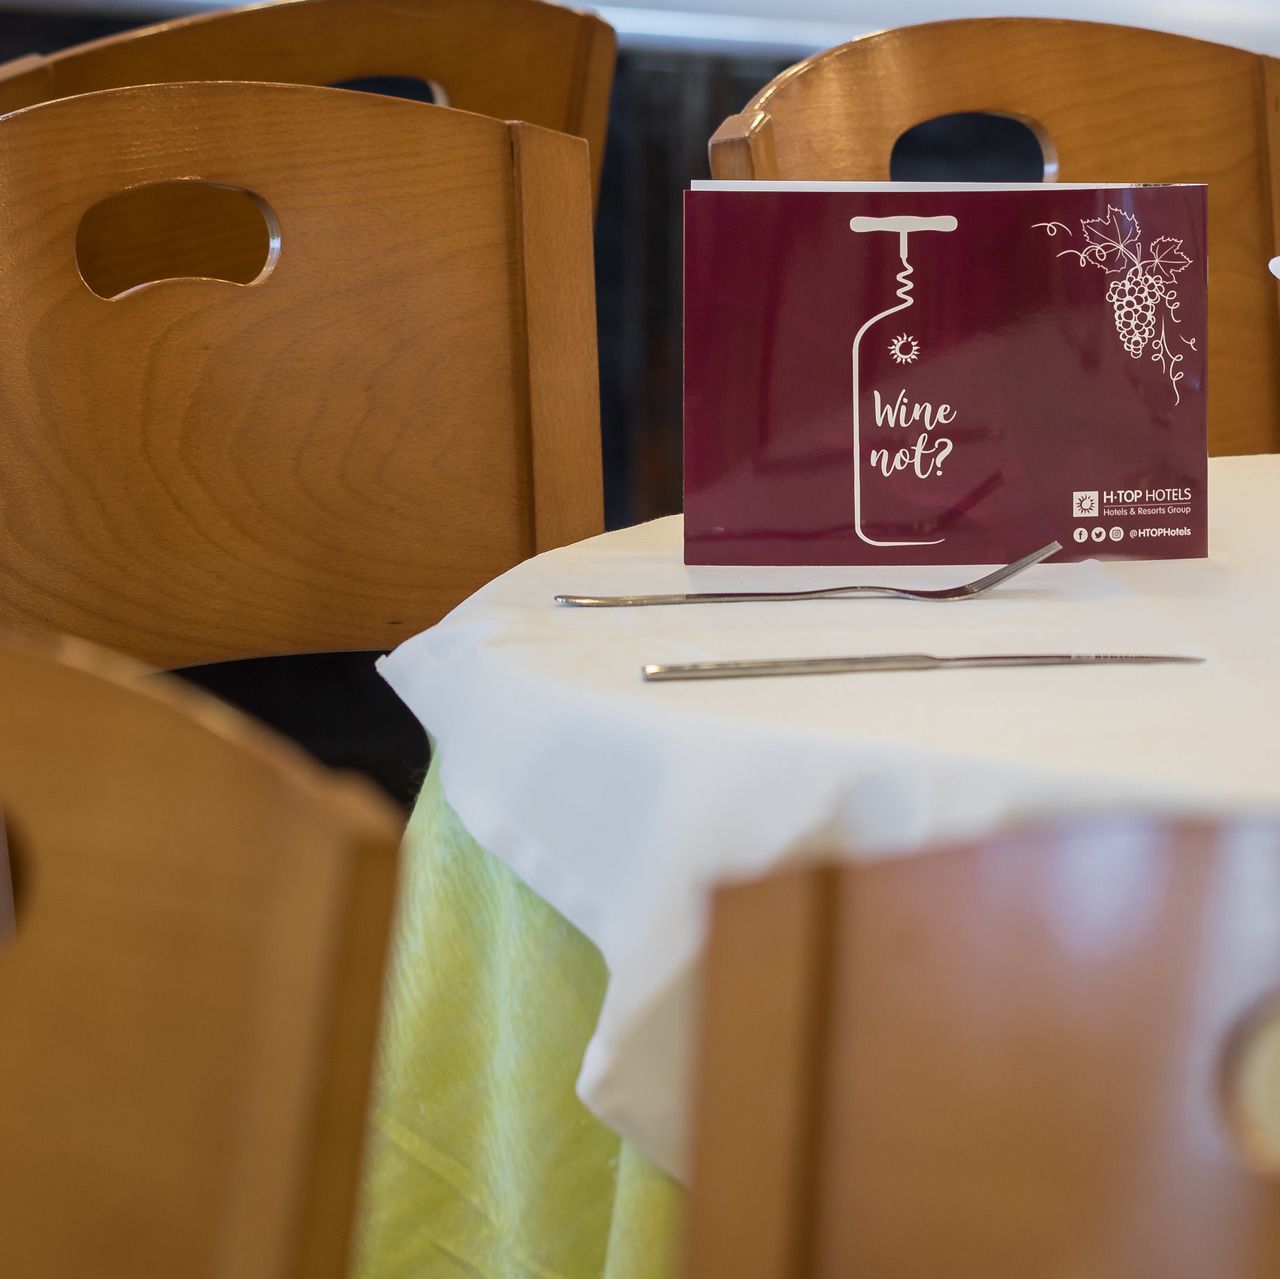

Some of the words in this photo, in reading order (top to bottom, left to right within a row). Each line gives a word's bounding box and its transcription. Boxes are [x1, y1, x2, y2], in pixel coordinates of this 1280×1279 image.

[873, 388, 957, 430] Wine
[870, 433, 953, 479] not?
[1145, 487, 1192, 502] HOTELS
[1103, 508, 1128, 516] Hotels
[1137, 506, 1166, 515] Resorts
[1167, 505, 1192, 515] Group
